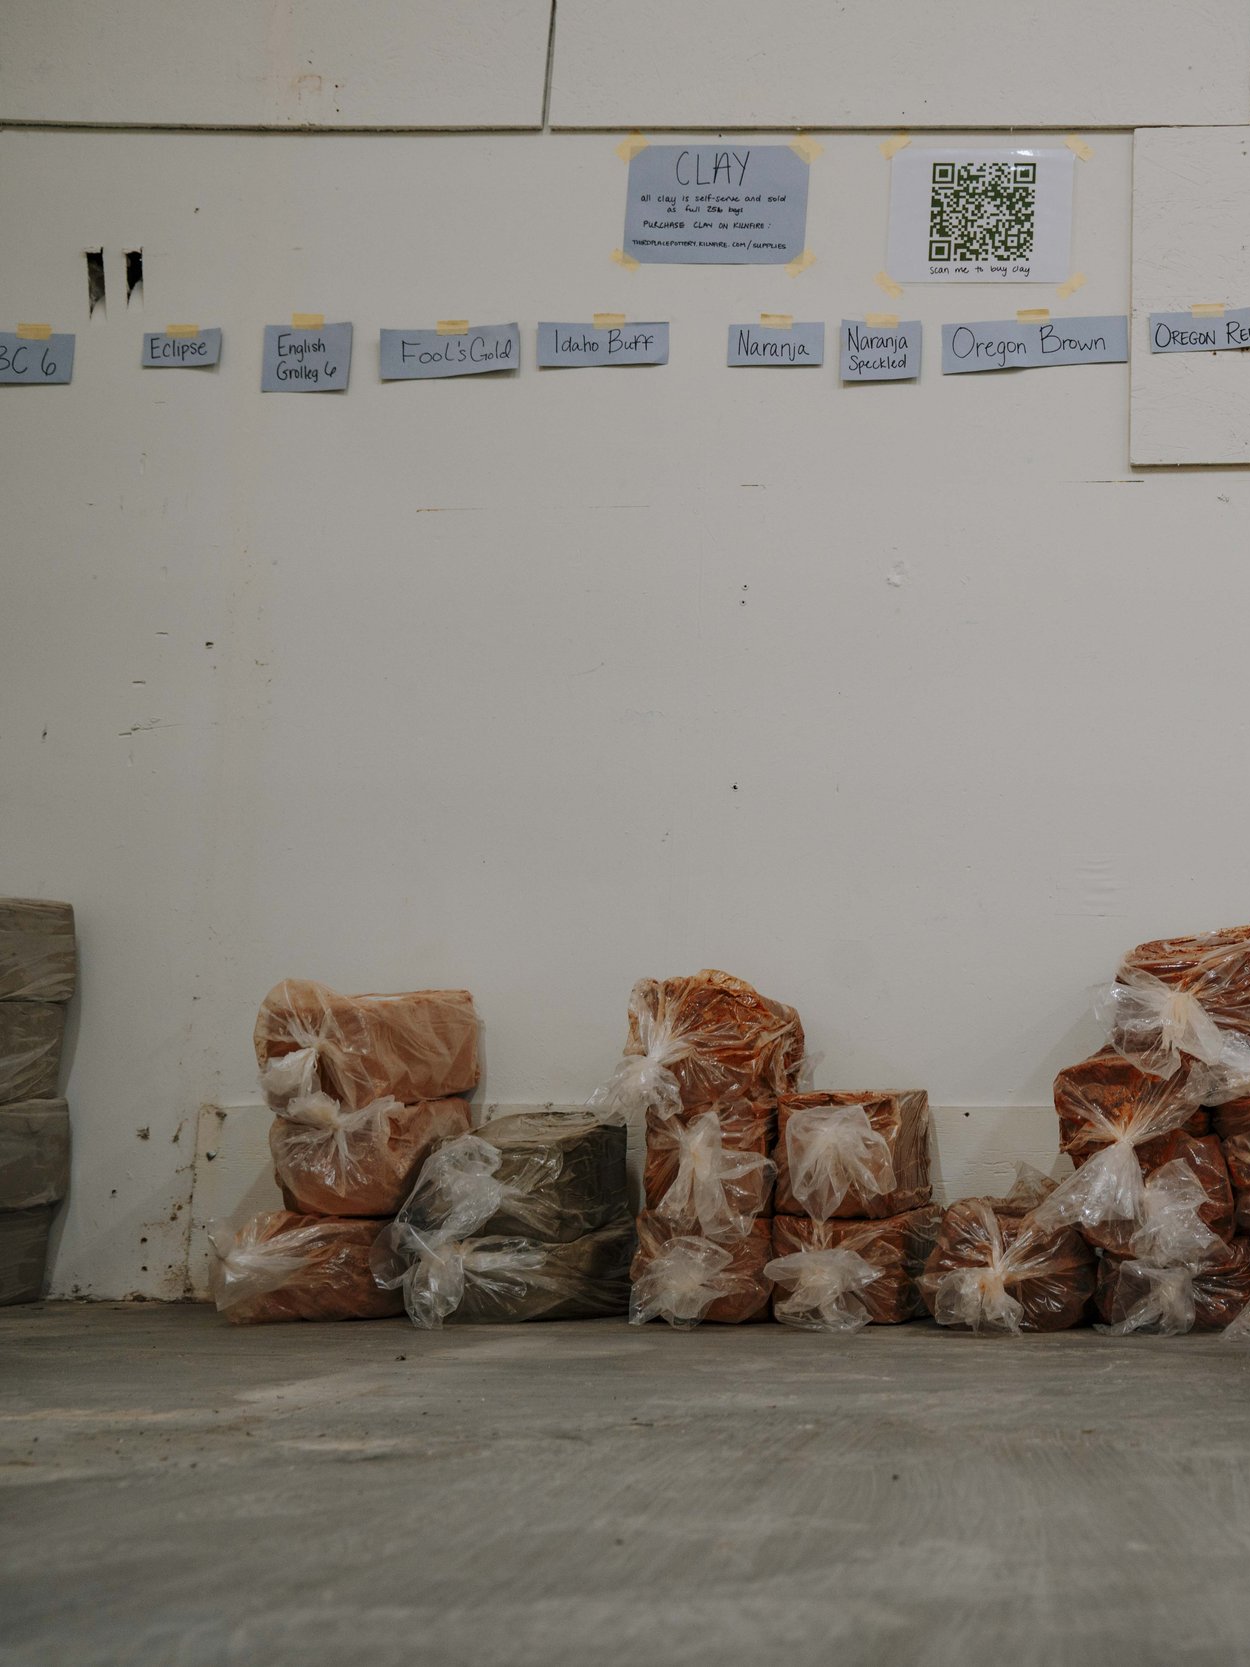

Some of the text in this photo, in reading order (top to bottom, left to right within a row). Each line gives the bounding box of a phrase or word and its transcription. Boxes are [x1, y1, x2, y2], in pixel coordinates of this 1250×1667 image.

[676, 151, 750, 186] CLAY
[640, 194, 786, 206] all clay is self-serve and sold
[685, 204, 700, 213] full
[643, 220, 685, 229] PURCHASE
[929, 265, 949, 275] scan
[990, 265, 1007, 276] buy
[1012, 265, 1030, 276] clay
[150, 337, 208, 361] Eclipse
[277, 333, 326, 362] English
[470, 336, 512, 362] Gold
[555, 329, 654, 354] Idaho Buff
[737, 330, 810, 362] Naranja
[847, 326, 909, 352] Naranja
[952, 325, 1107, 367] Oregon Brown
[41, 347, 57, 376] 6
[276, 360, 337, 382] Grolleg 6
[848, 356, 907, 375] Speckled
